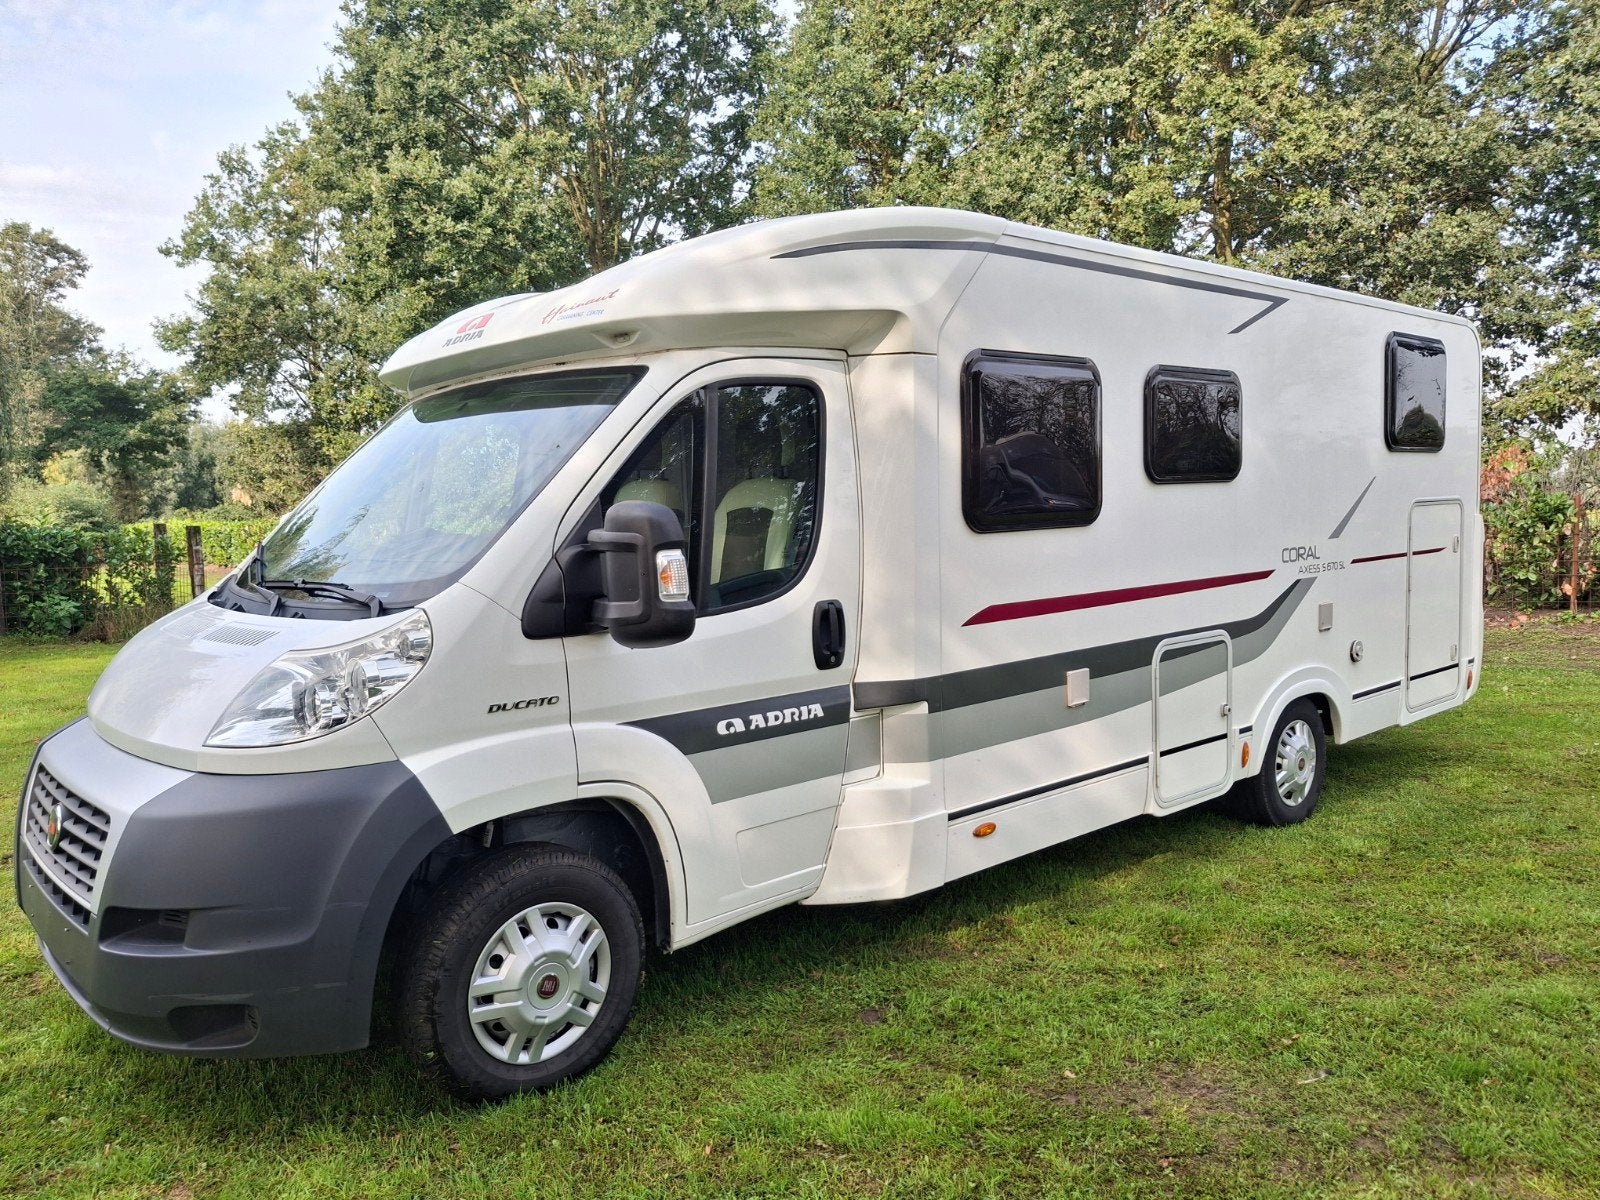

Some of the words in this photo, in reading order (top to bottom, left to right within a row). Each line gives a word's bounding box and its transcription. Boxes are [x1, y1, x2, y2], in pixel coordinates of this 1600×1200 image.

[442, 329, 485, 348] ADRIA
[1281, 545, 1320, 563] CORAL
[1298, 564, 1320, 574] AXESS
[487, 695, 560, 713] DUCATO
[749, 703, 824, 730] ADRIA
